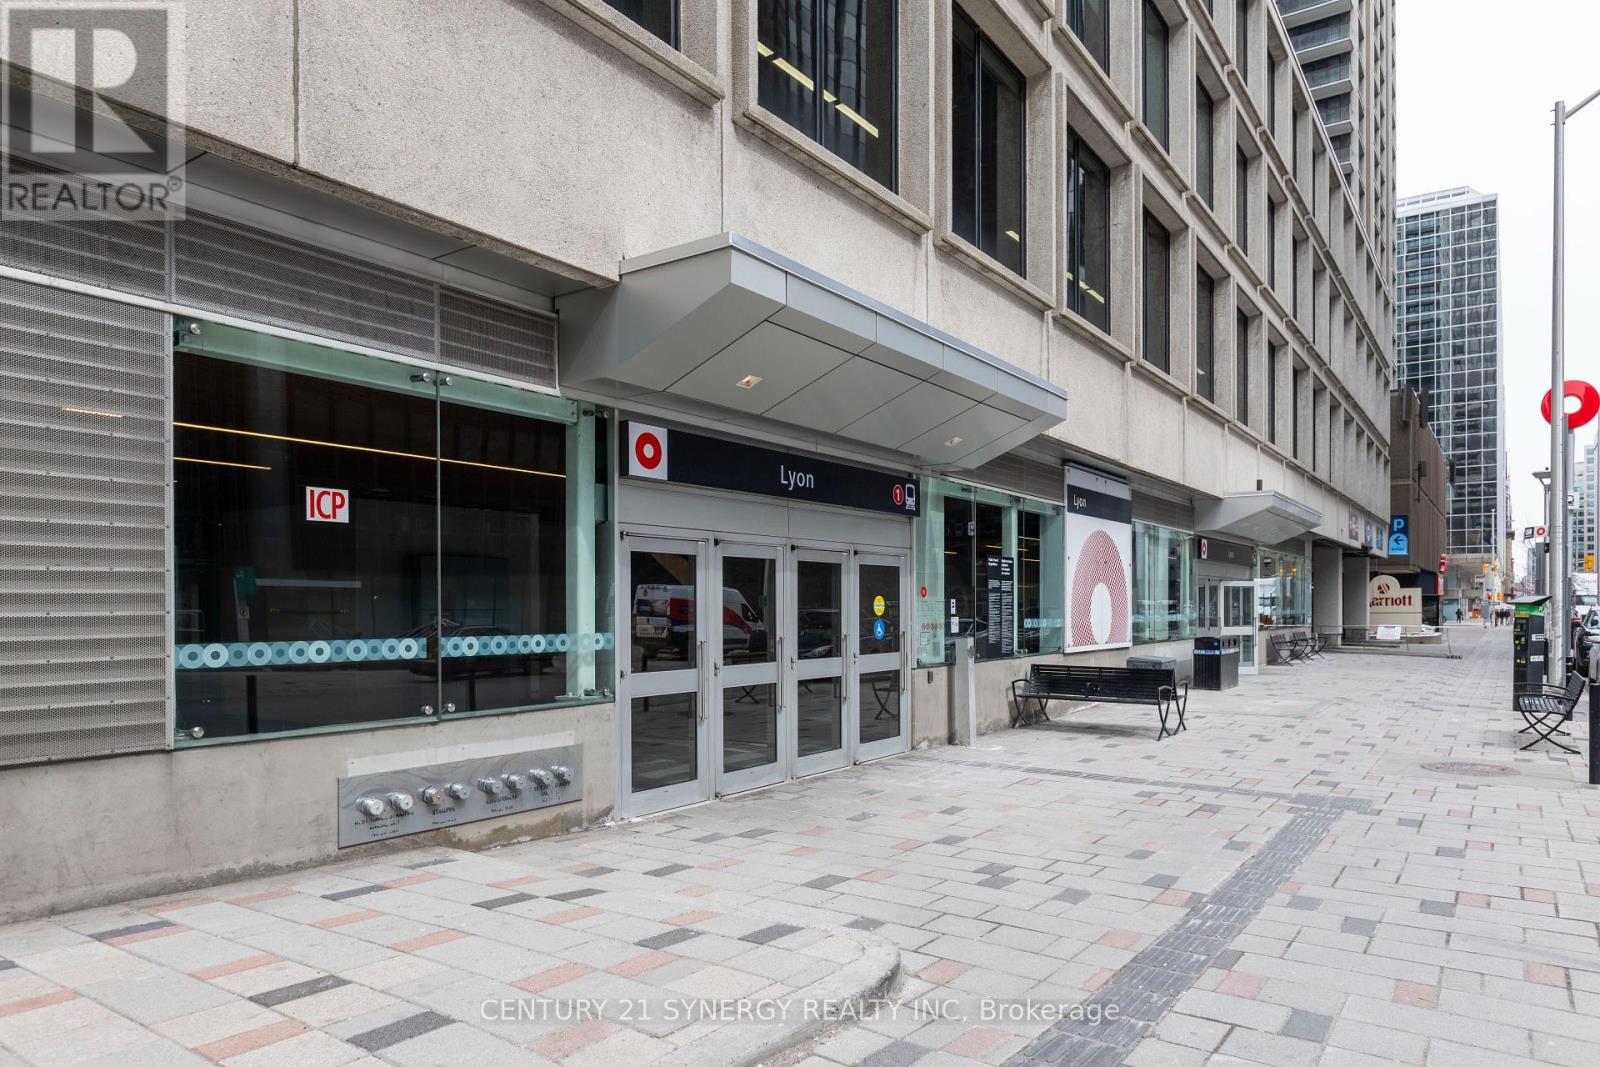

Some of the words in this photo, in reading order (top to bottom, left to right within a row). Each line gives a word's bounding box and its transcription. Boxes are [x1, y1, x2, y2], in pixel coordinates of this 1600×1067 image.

[780, 464, 814, 491] Lyon
[309, 489, 346, 520] ICP
[1073, 493, 1087, 510] Lyon
[1393, 518, 1405, 531] P
[1369, 594, 1412, 607] arriott
